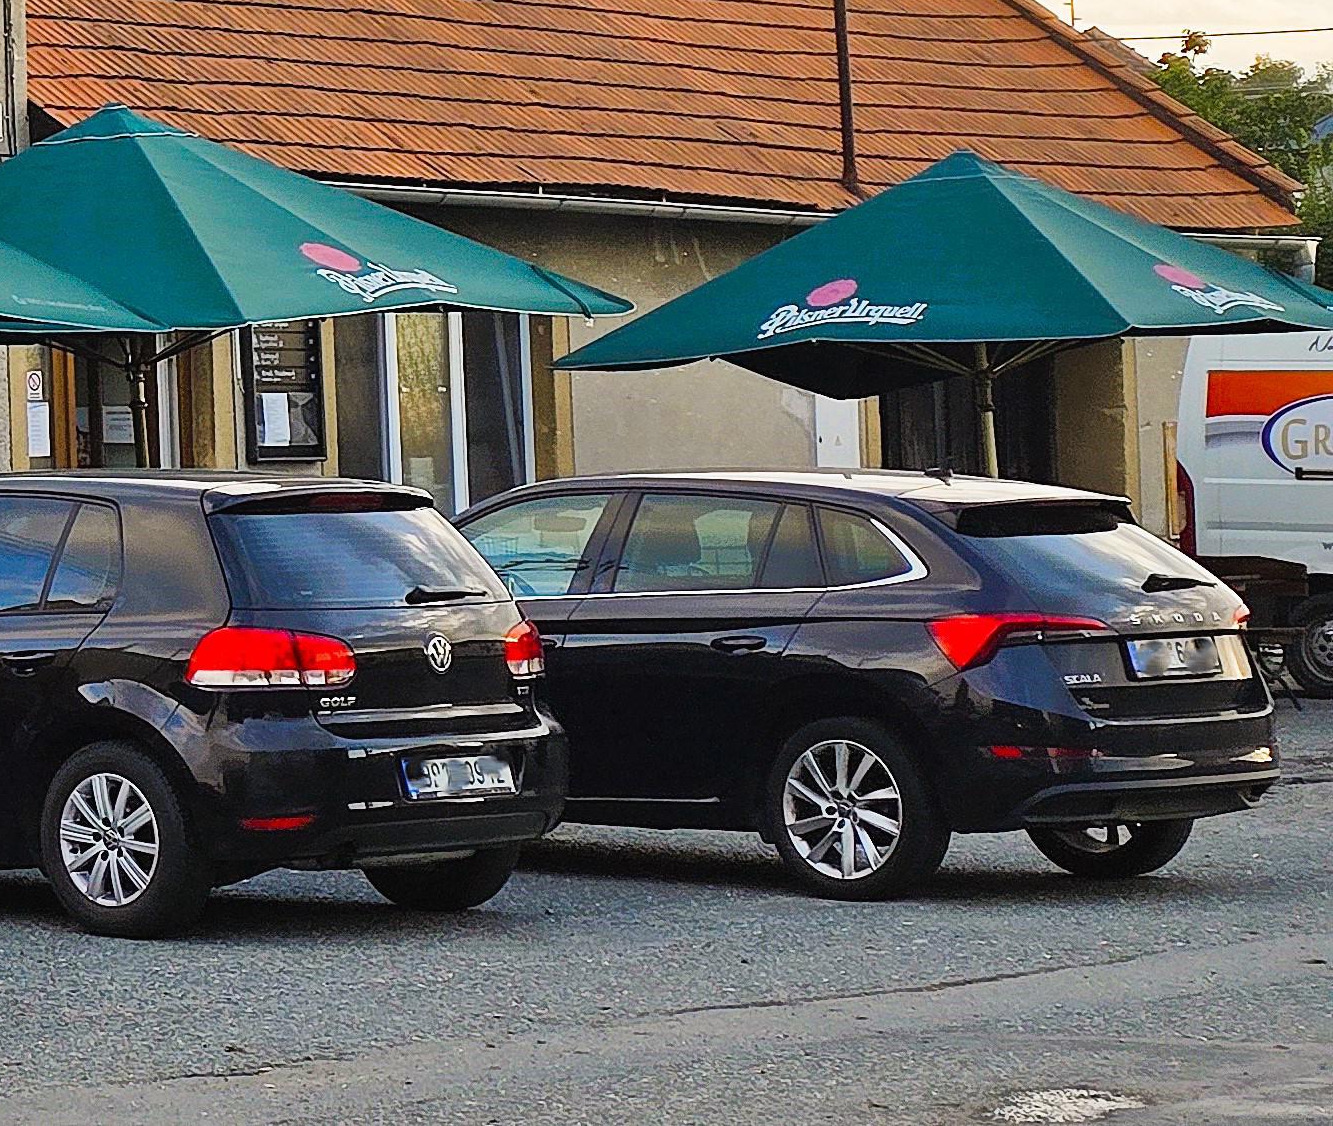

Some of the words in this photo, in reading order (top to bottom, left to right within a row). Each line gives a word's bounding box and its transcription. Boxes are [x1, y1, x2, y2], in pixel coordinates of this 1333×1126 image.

[757, 304, 850, 340] Pilsner
[844, 298, 928, 326] Urquell
[1064, 674, 1102, 685] SCALA
[320, 696, 356, 708] GOLF
